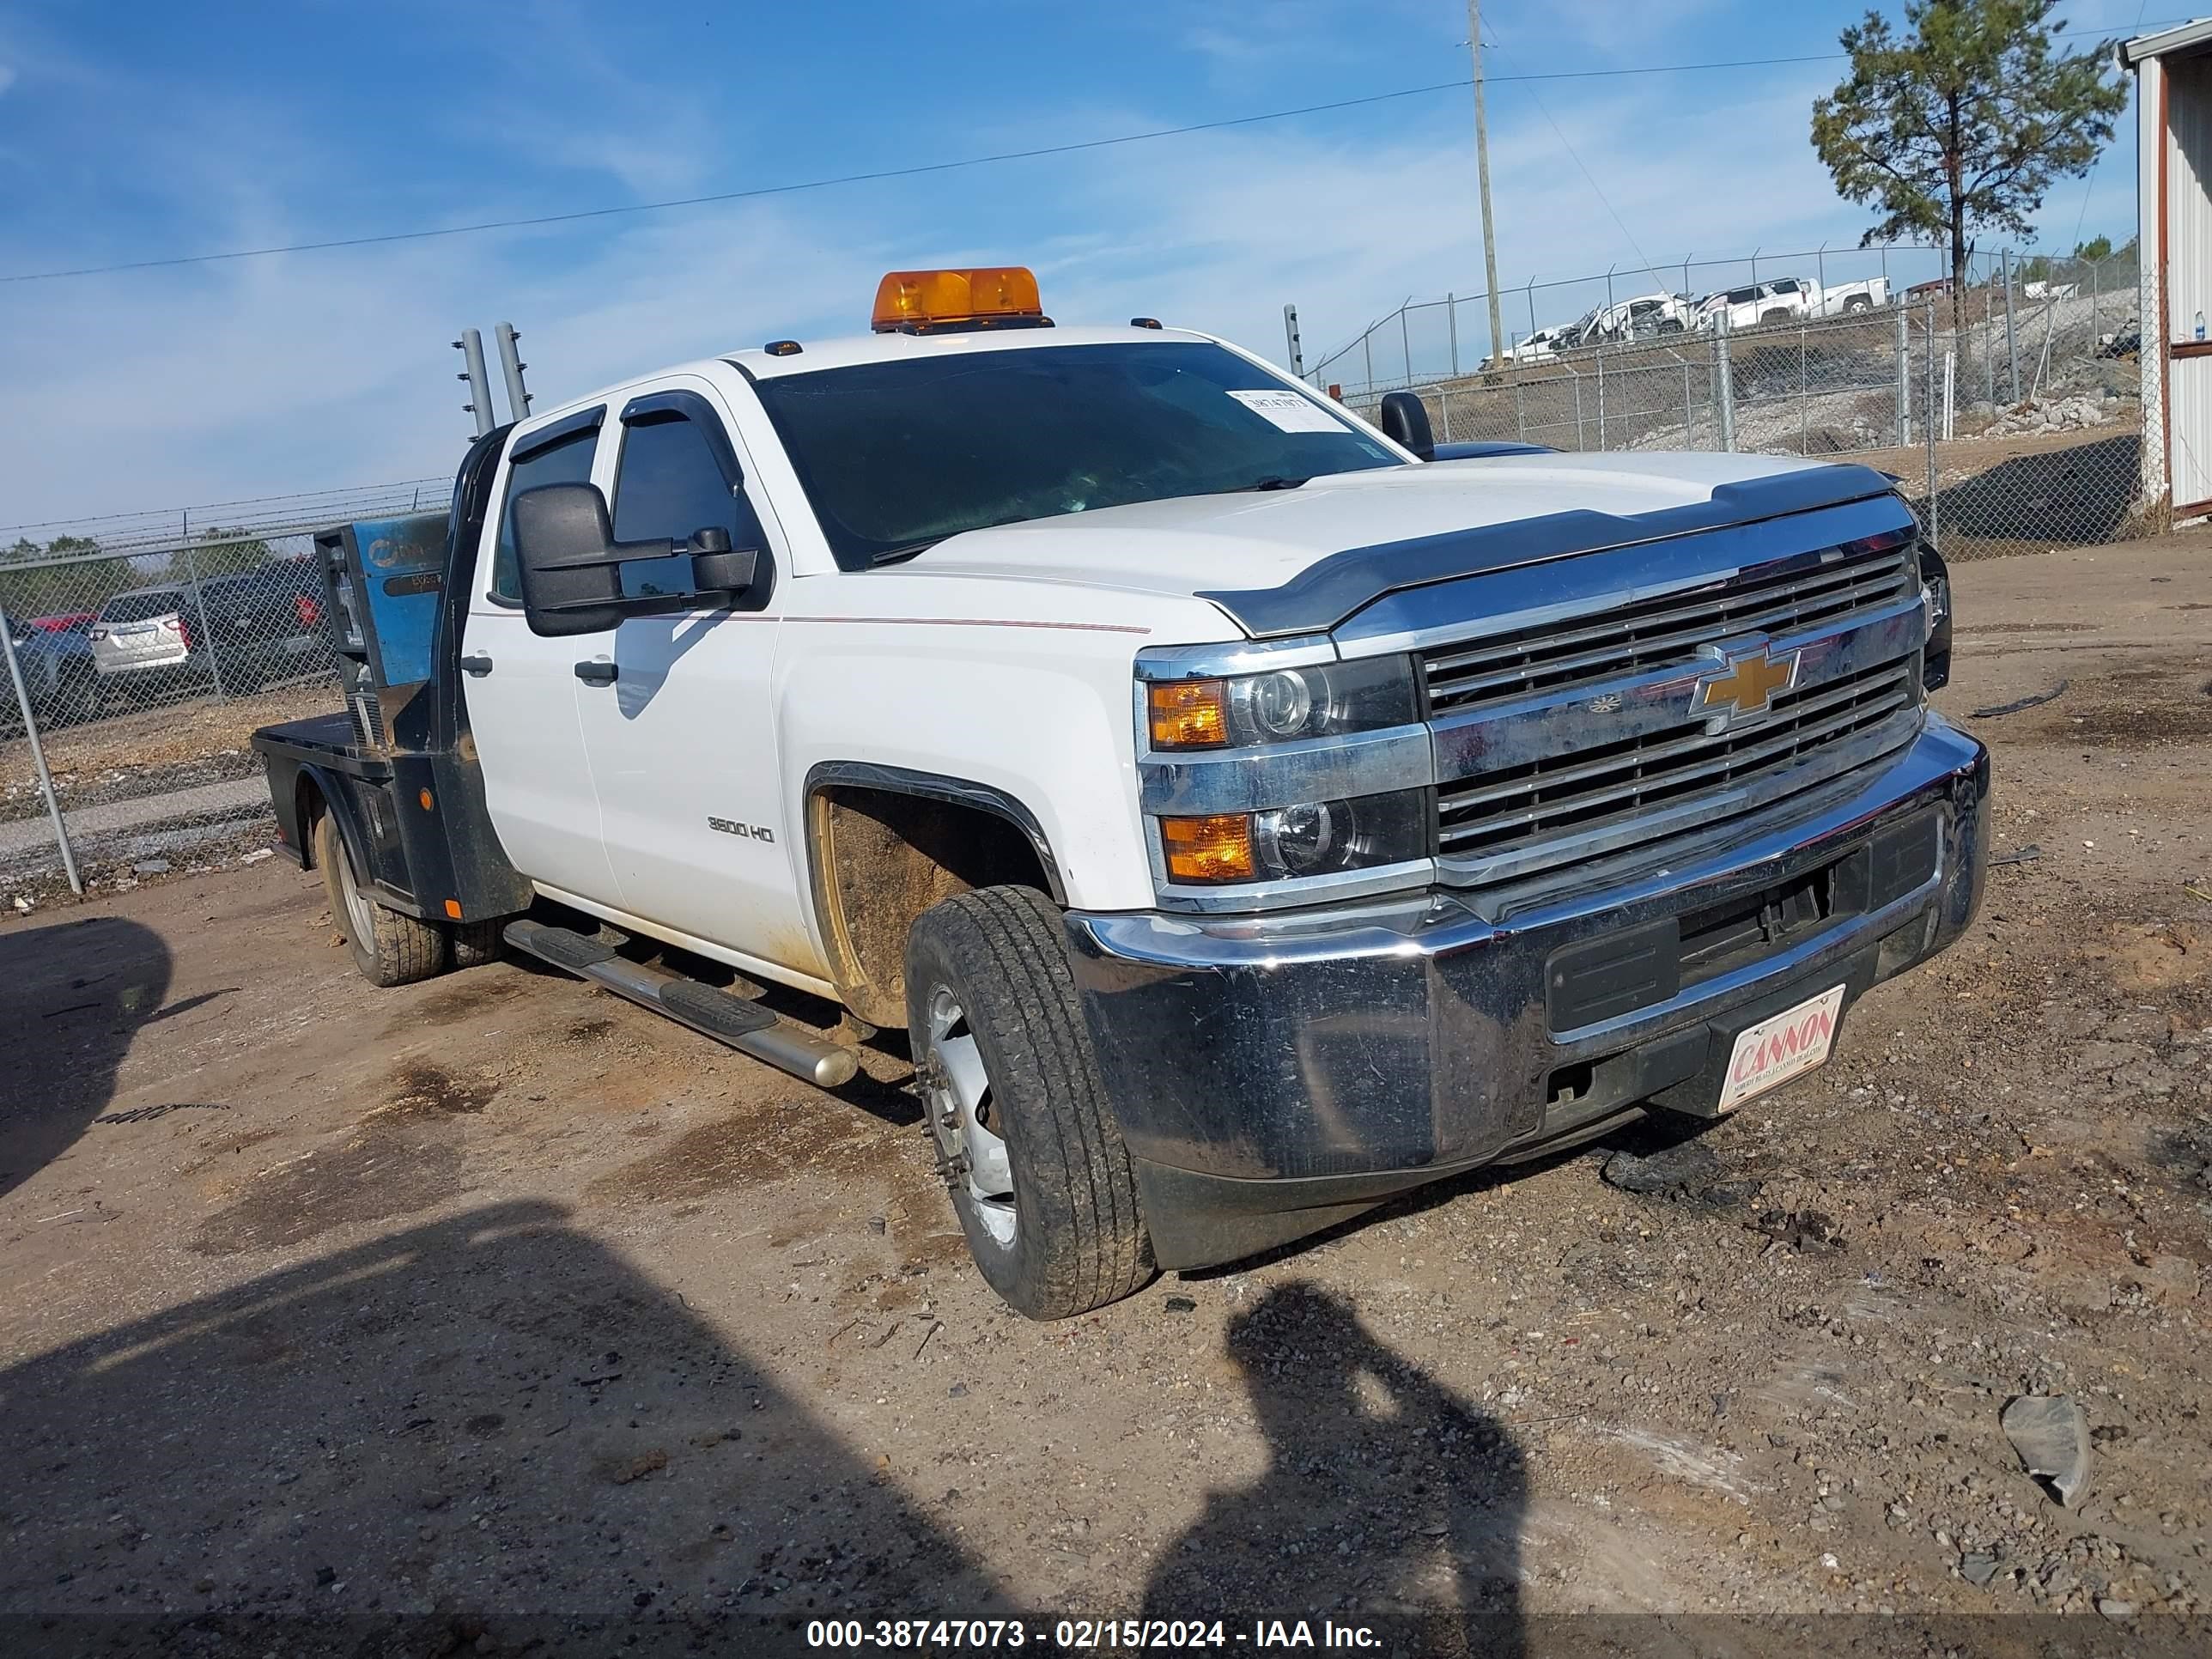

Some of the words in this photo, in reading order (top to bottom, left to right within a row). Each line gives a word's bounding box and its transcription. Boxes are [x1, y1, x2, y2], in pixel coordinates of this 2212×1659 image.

[1248, 398, 1309, 408] 38747073
[708, 816, 750, 838] 3500
[750, 824, 775, 843] HD
[1733, 1003, 1837, 1084] CANNON
